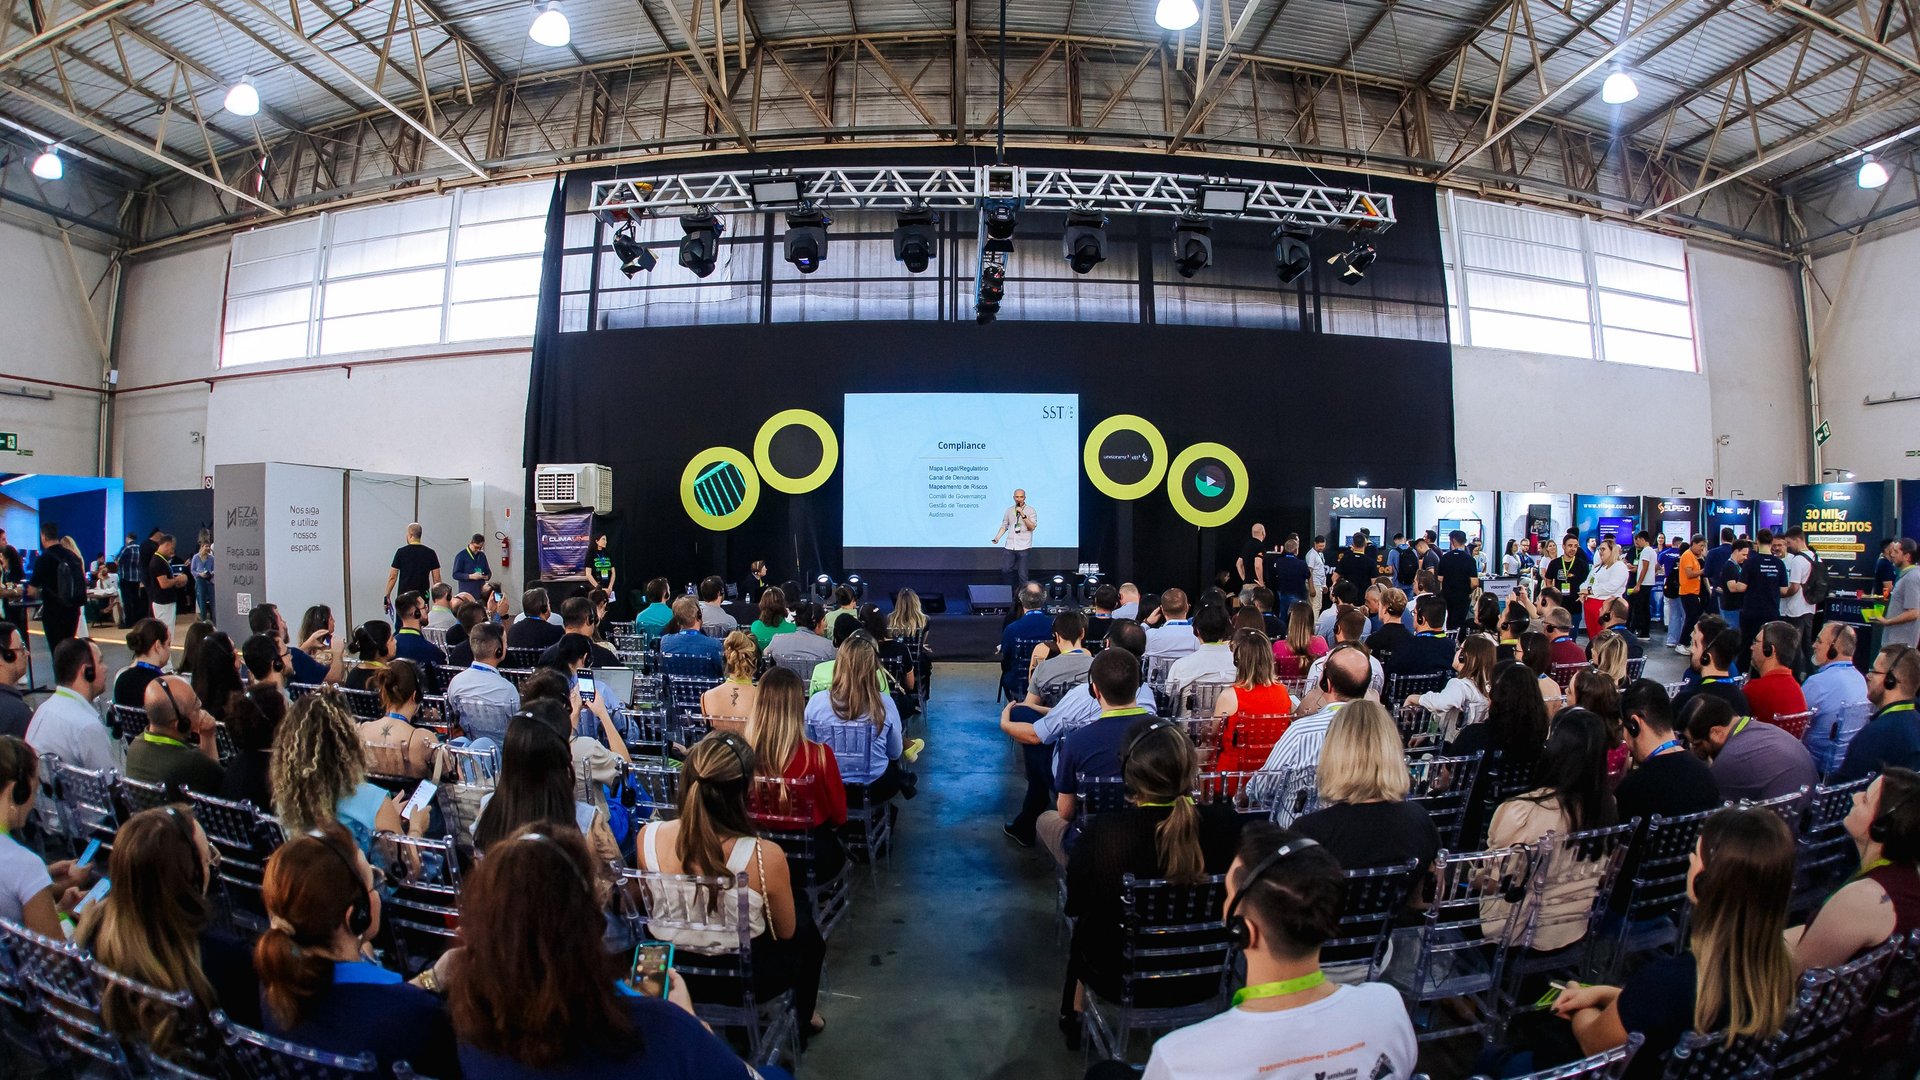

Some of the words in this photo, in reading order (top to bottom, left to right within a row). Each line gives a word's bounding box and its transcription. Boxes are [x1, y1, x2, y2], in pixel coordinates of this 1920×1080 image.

[938, 441, 986, 451] Compliance
[1332, 494, 1387, 509] selbetti
[1435, 495, 1468, 504] Valorem
[290, 505, 304, 514] Nos
[305, 507, 320, 515] siga
[1805, 508, 1820, 520] 30
[1821, 508, 1840, 520] MIL
[291, 519, 296, 527] e
[297, 517, 318, 527] utilize
[1802, 521, 1818, 532] EM
[1818, 519, 1873, 532] CRÉDITOS
[293, 531, 317, 540] nossos
[226, 546, 244, 558] Faça
[246, 548, 260, 556] sua
[291, 544, 321, 553] espaços.
[229, 561, 258, 571] reunião
[233, 575, 254, 586] AQUI
